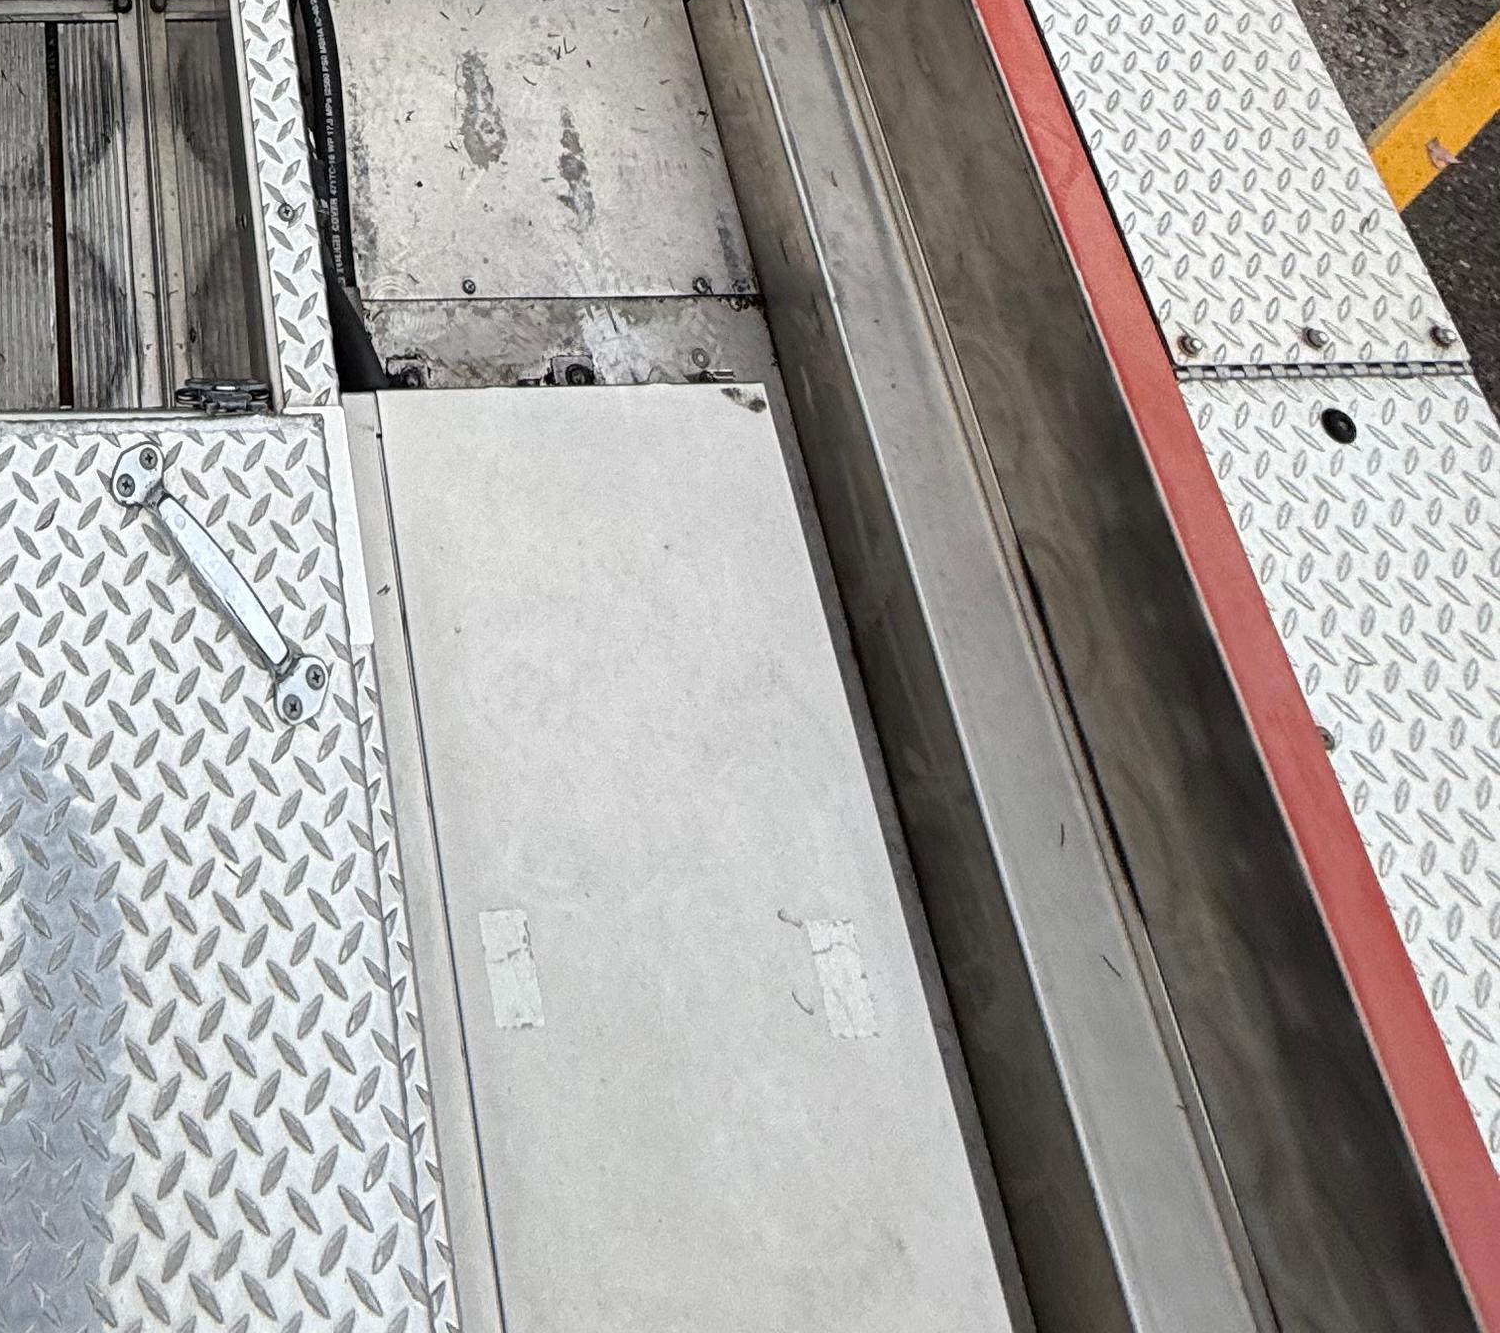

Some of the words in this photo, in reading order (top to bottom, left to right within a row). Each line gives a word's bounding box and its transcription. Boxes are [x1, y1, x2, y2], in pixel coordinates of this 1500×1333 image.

[327, 137, 335, 153] WP
[328, 154, 337, 196] 471TC-16
[329, 198, 340, 232] COVER
